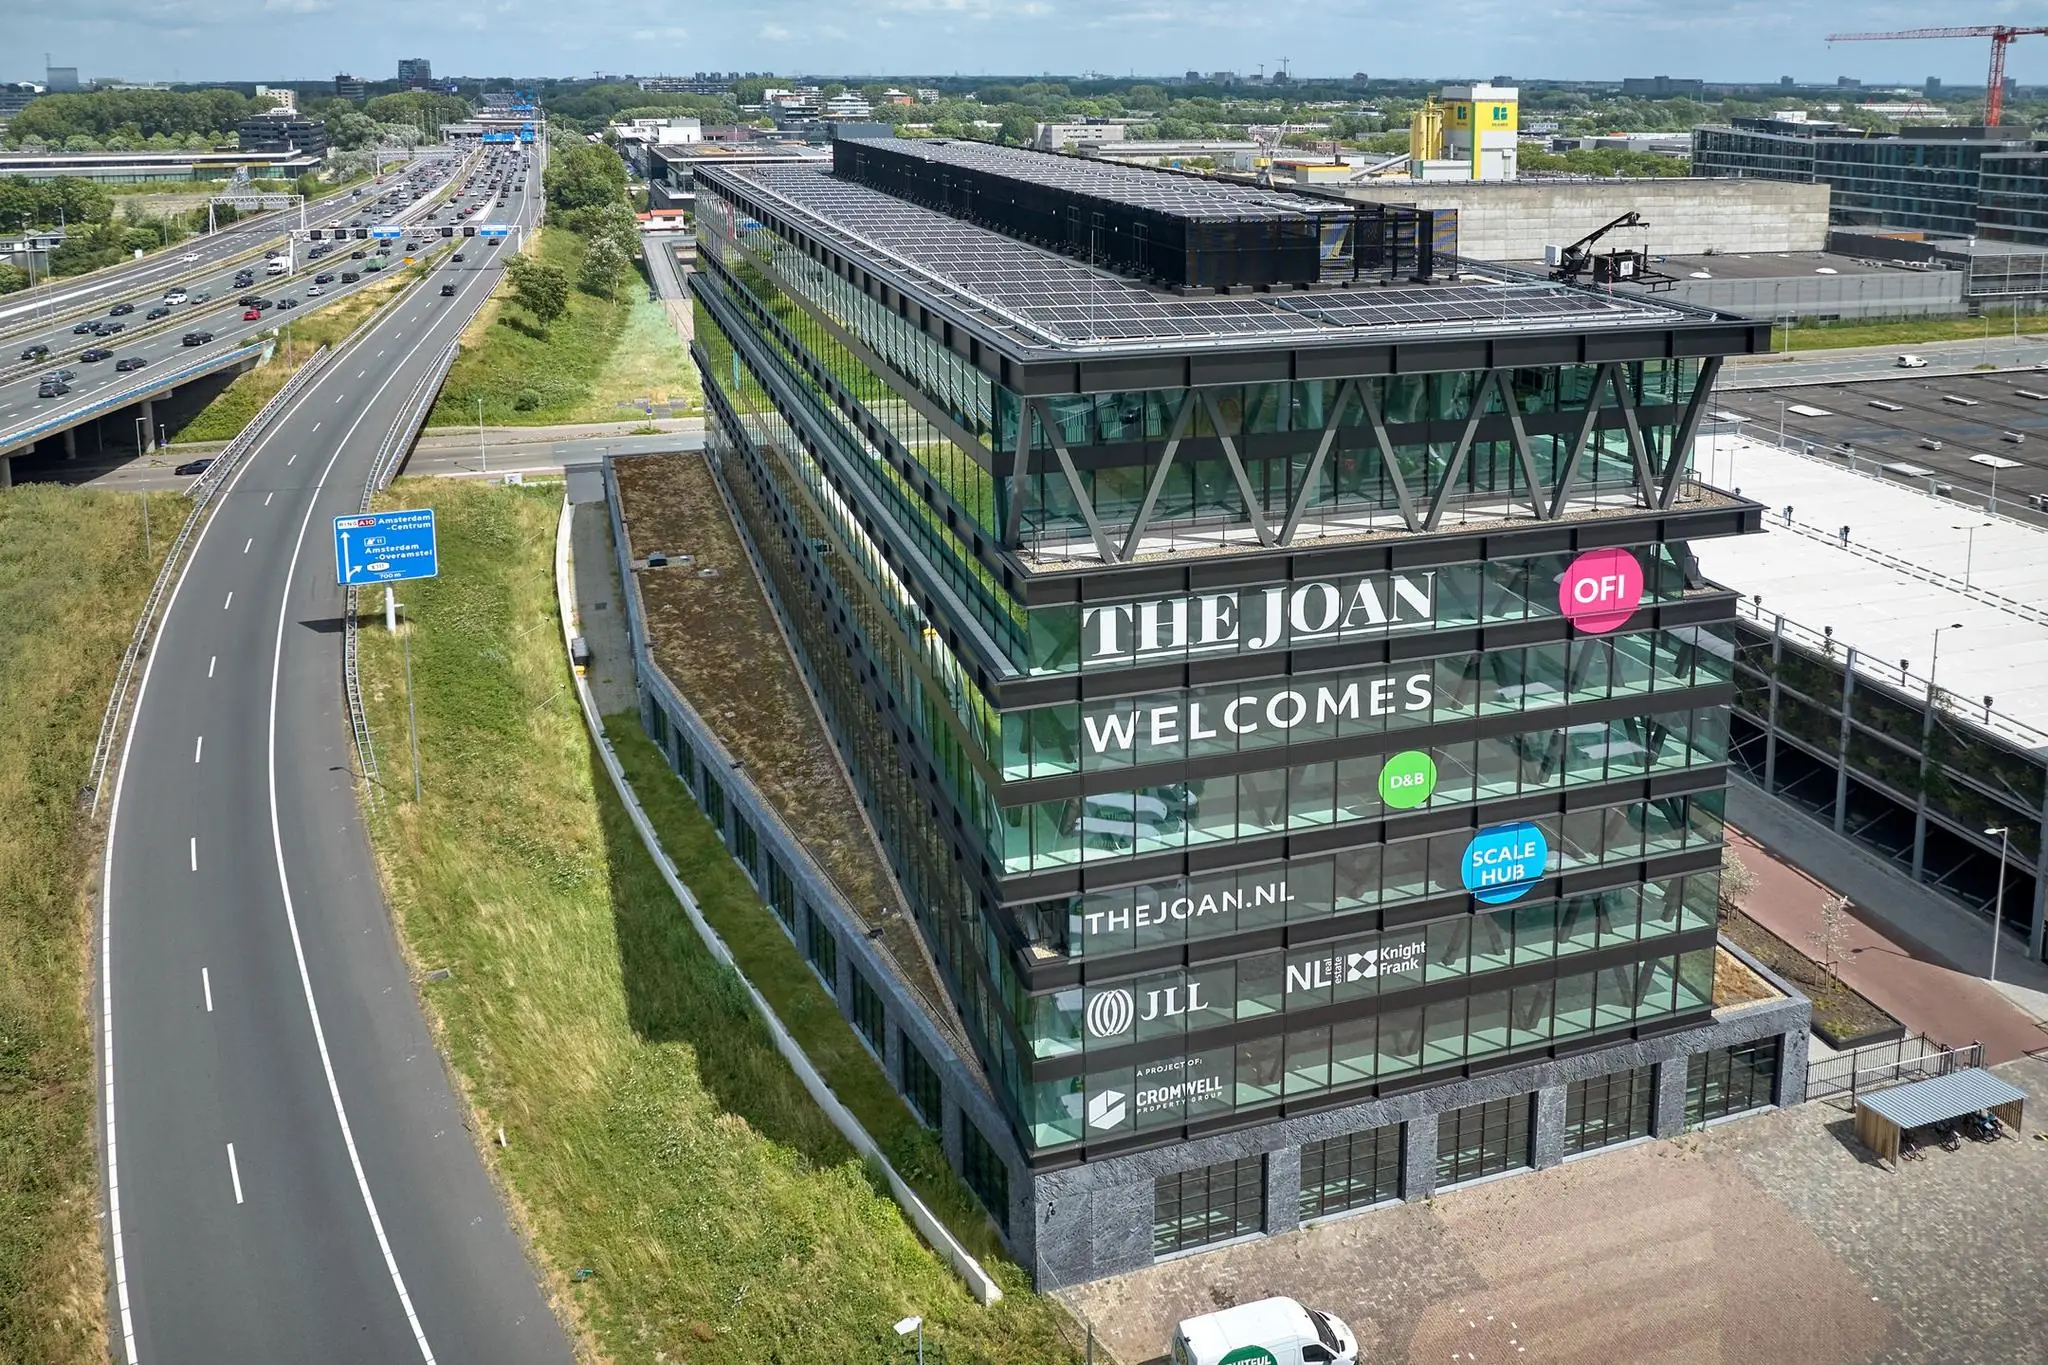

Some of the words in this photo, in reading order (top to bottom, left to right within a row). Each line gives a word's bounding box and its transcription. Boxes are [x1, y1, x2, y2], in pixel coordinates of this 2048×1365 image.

[358, 518, 374, 526] A10
[378, 515, 431, 524] Amsterdam
[365, 544, 419, 554] Amsterdam
[1574, 573, 1625, 604] OFI
[1082, 591, 1239, 657] THE
[1248, 571, 1436, 650] JOAN
[1083, 673, 1433, 753] WELCOMES
[1390, 772, 1425, 789] D&B
[1472, 841, 1536, 868] SCALE
[1481, 864, 1525, 886] HUB
[1085, 881, 1295, 935] THEJOAN.NL
[1379, 940, 1426, 960] Knight
[1286, 959, 1332, 994] NL
[1325, 957, 1333, 976] real
[1333, 956, 1343, 985] estate
[1379, 958, 1420, 976] Frank
[1140, 982, 1209, 1022] JLL
[1136, 1069, 1144, 1078] A
[1145, 1061, 1186, 1075] PROJECT
[1187, 1057, 1203, 1067] OF:
[1136, 1075, 1223, 1107] CROMWELL
[1136, 1099, 1186, 1115] PROPERTY
[1191, 1091, 1223, 1103] GROUP
